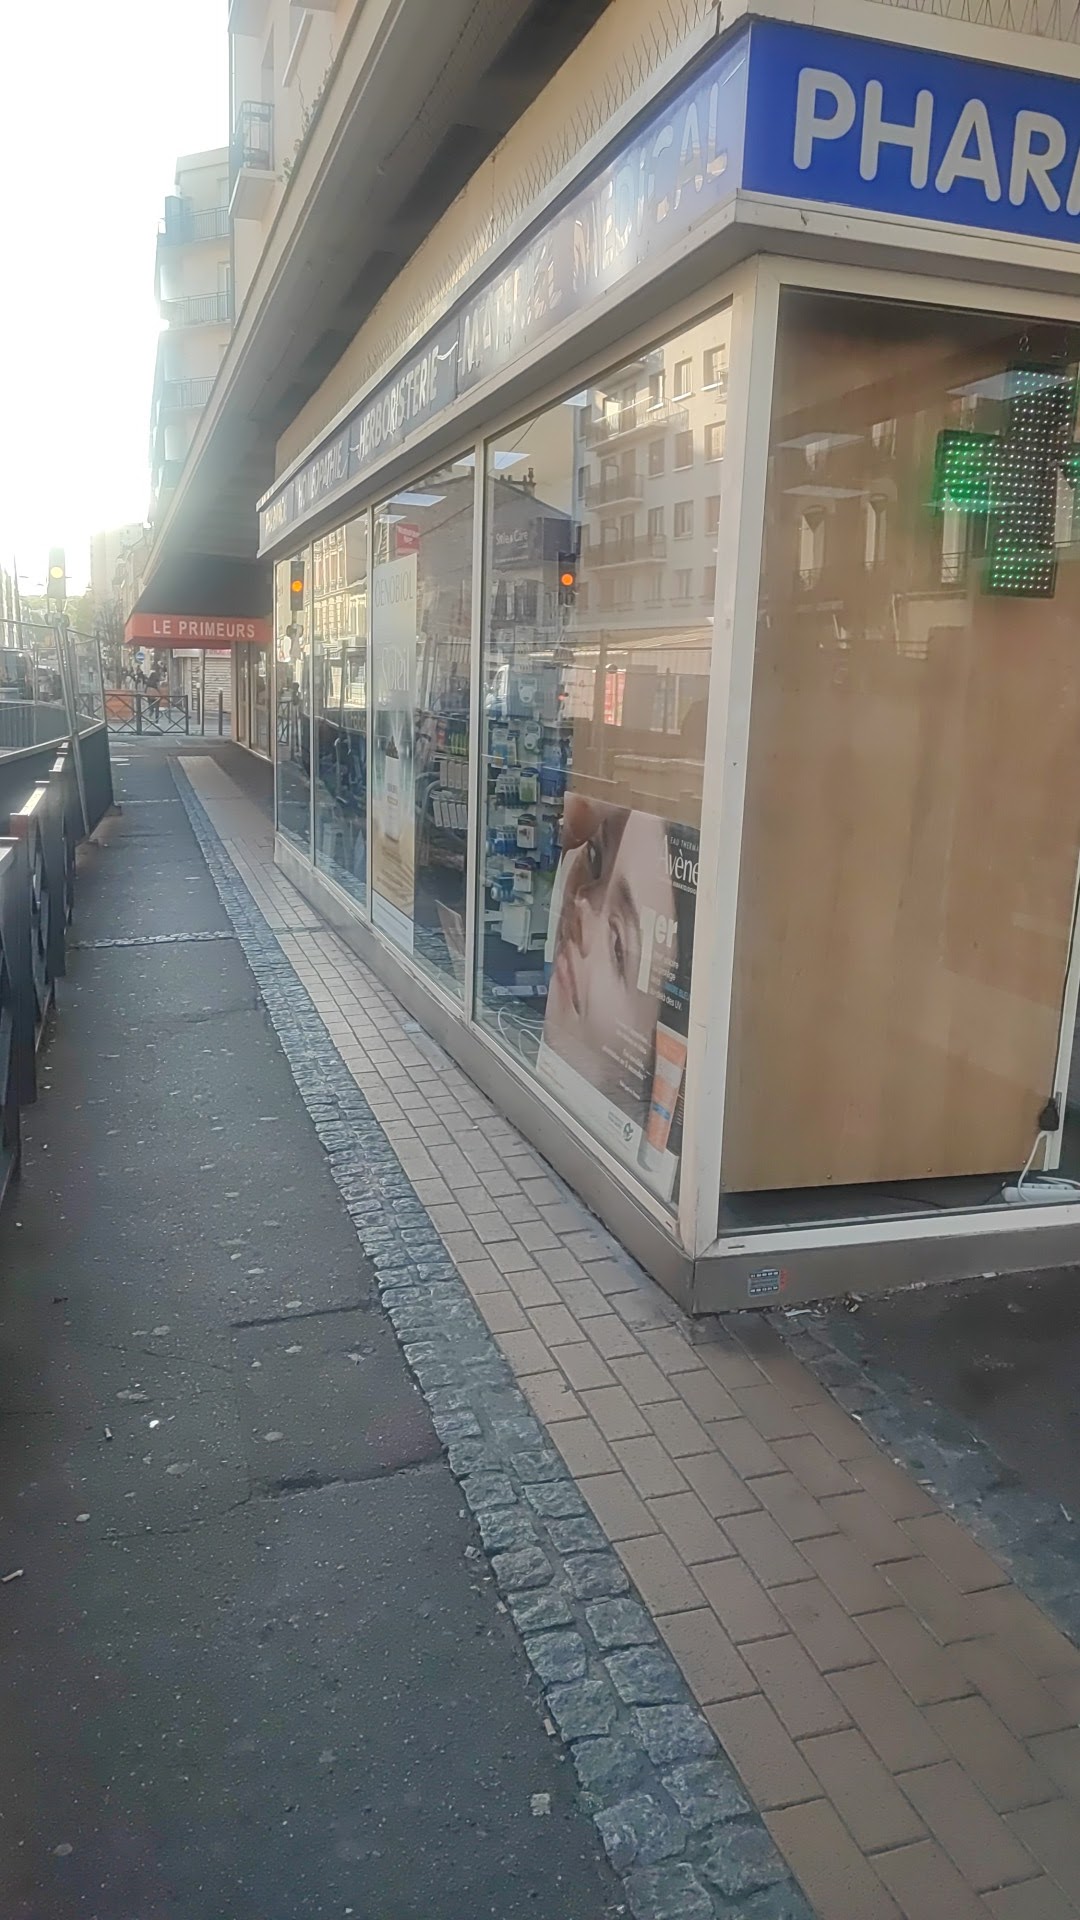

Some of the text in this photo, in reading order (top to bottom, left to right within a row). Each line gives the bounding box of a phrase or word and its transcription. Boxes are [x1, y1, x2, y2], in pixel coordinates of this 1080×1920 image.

[793, 67, 1080, 217] PHAR
[358, 345, 439, 461] HERBORISTERIE
[375, 568, 414, 608] OENOBIOL
[153, 619, 256, 638] LE PRIMEURS
